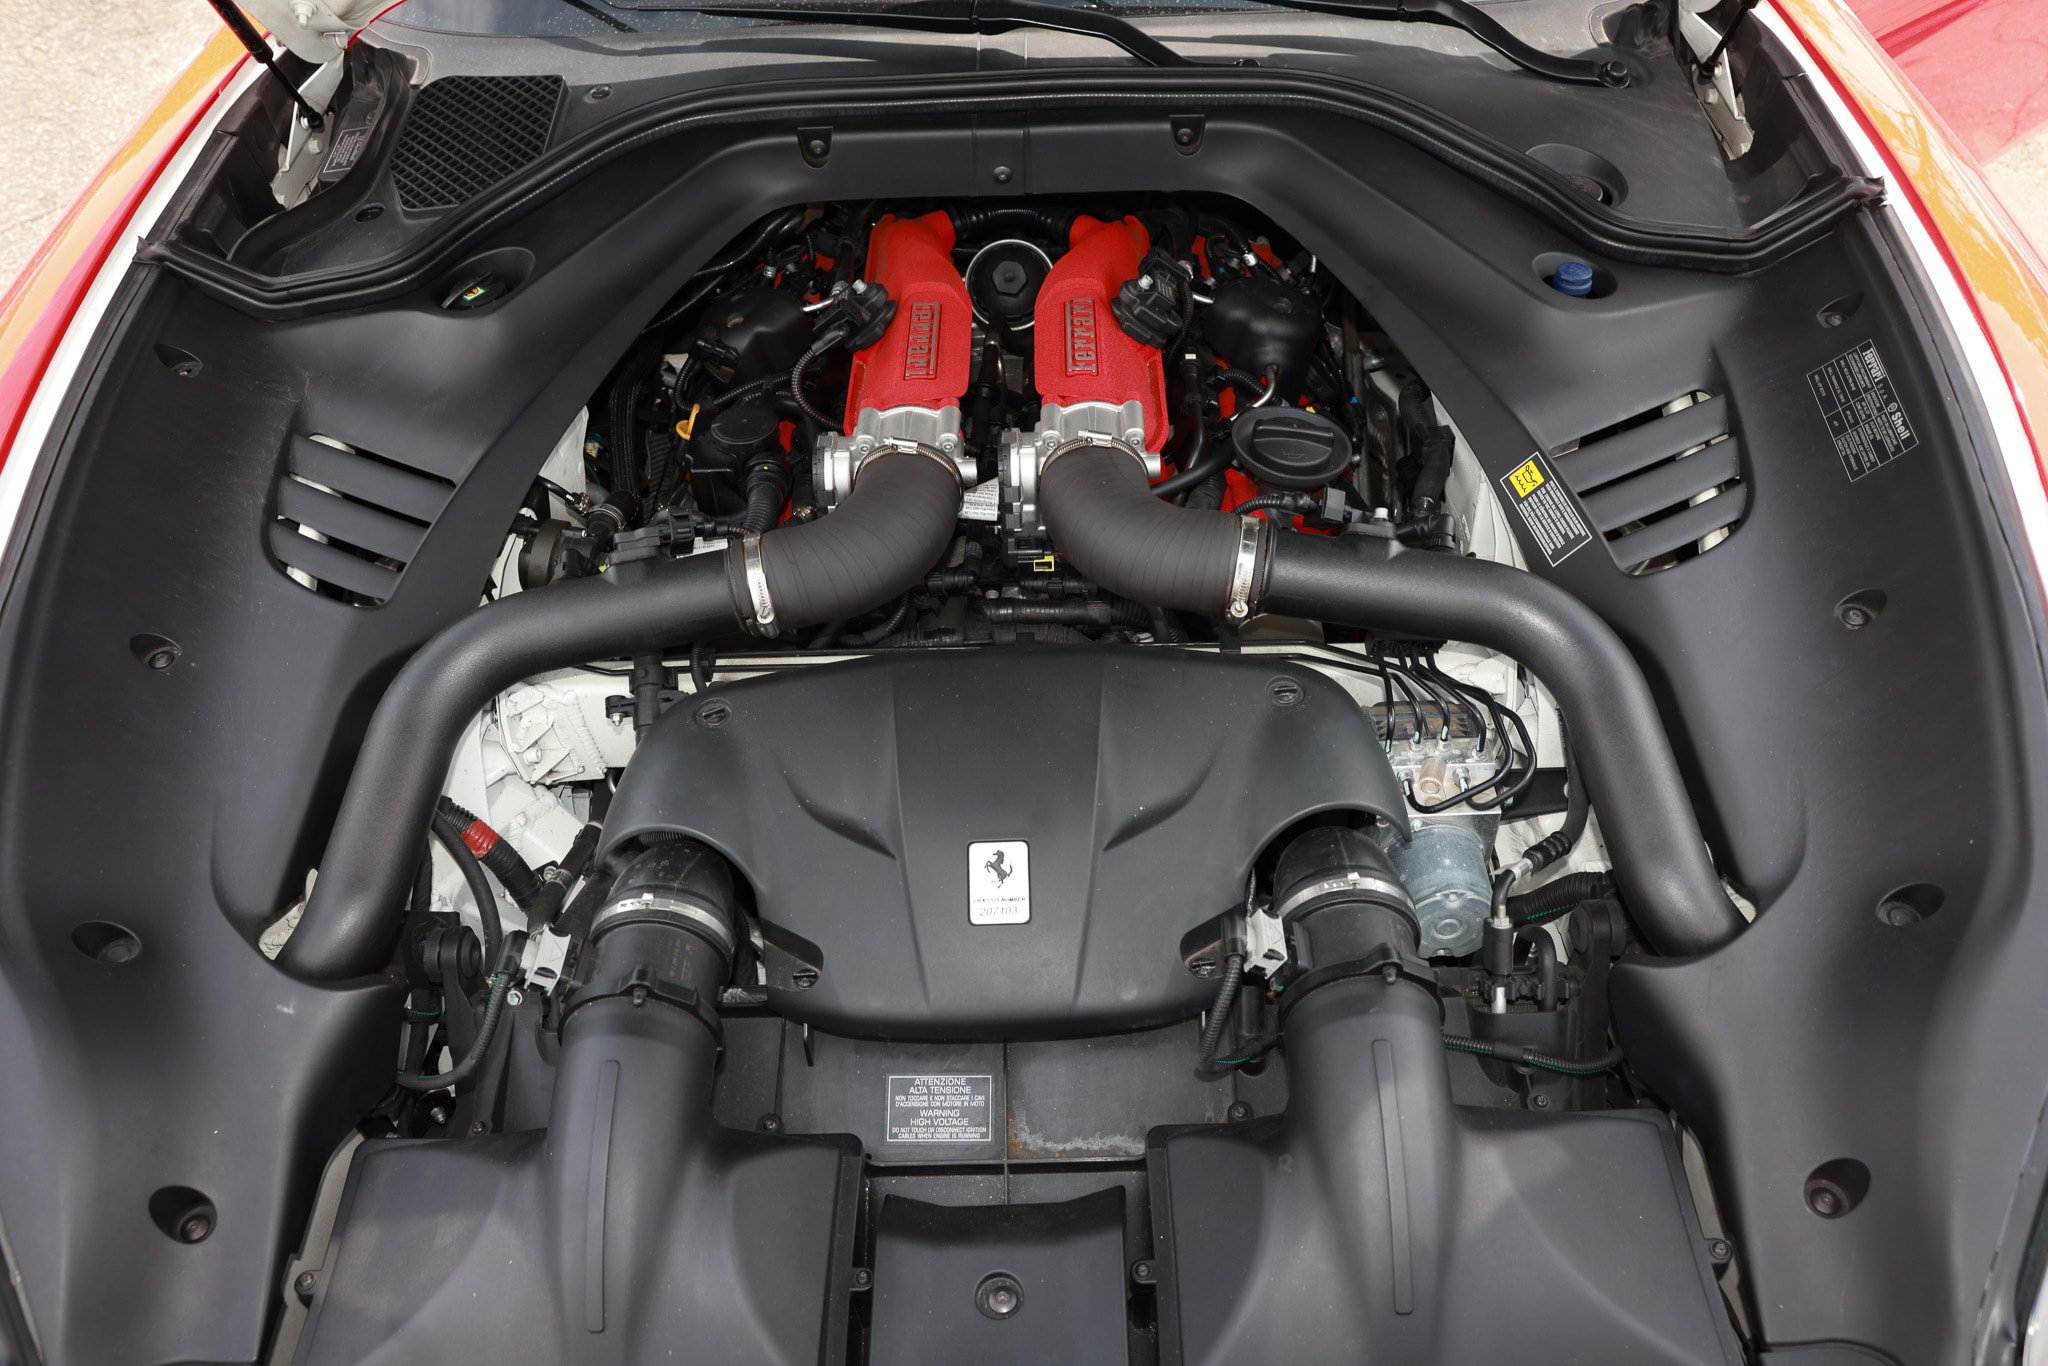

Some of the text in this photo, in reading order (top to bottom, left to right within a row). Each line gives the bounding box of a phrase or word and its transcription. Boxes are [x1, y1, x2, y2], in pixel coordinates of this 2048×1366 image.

[907, 301, 939, 375] Ferrari
[1067, 297, 1097, 372] Ferrari
[1862, 348, 1885, 381] Ferrari
[1891, 411, 1910, 439] Shell
[980, 906, 1018, 916] 207103
[910, 1118, 969, 1126] HIGH VOLTAGE
[920, 1109, 960, 1117] WARNING
